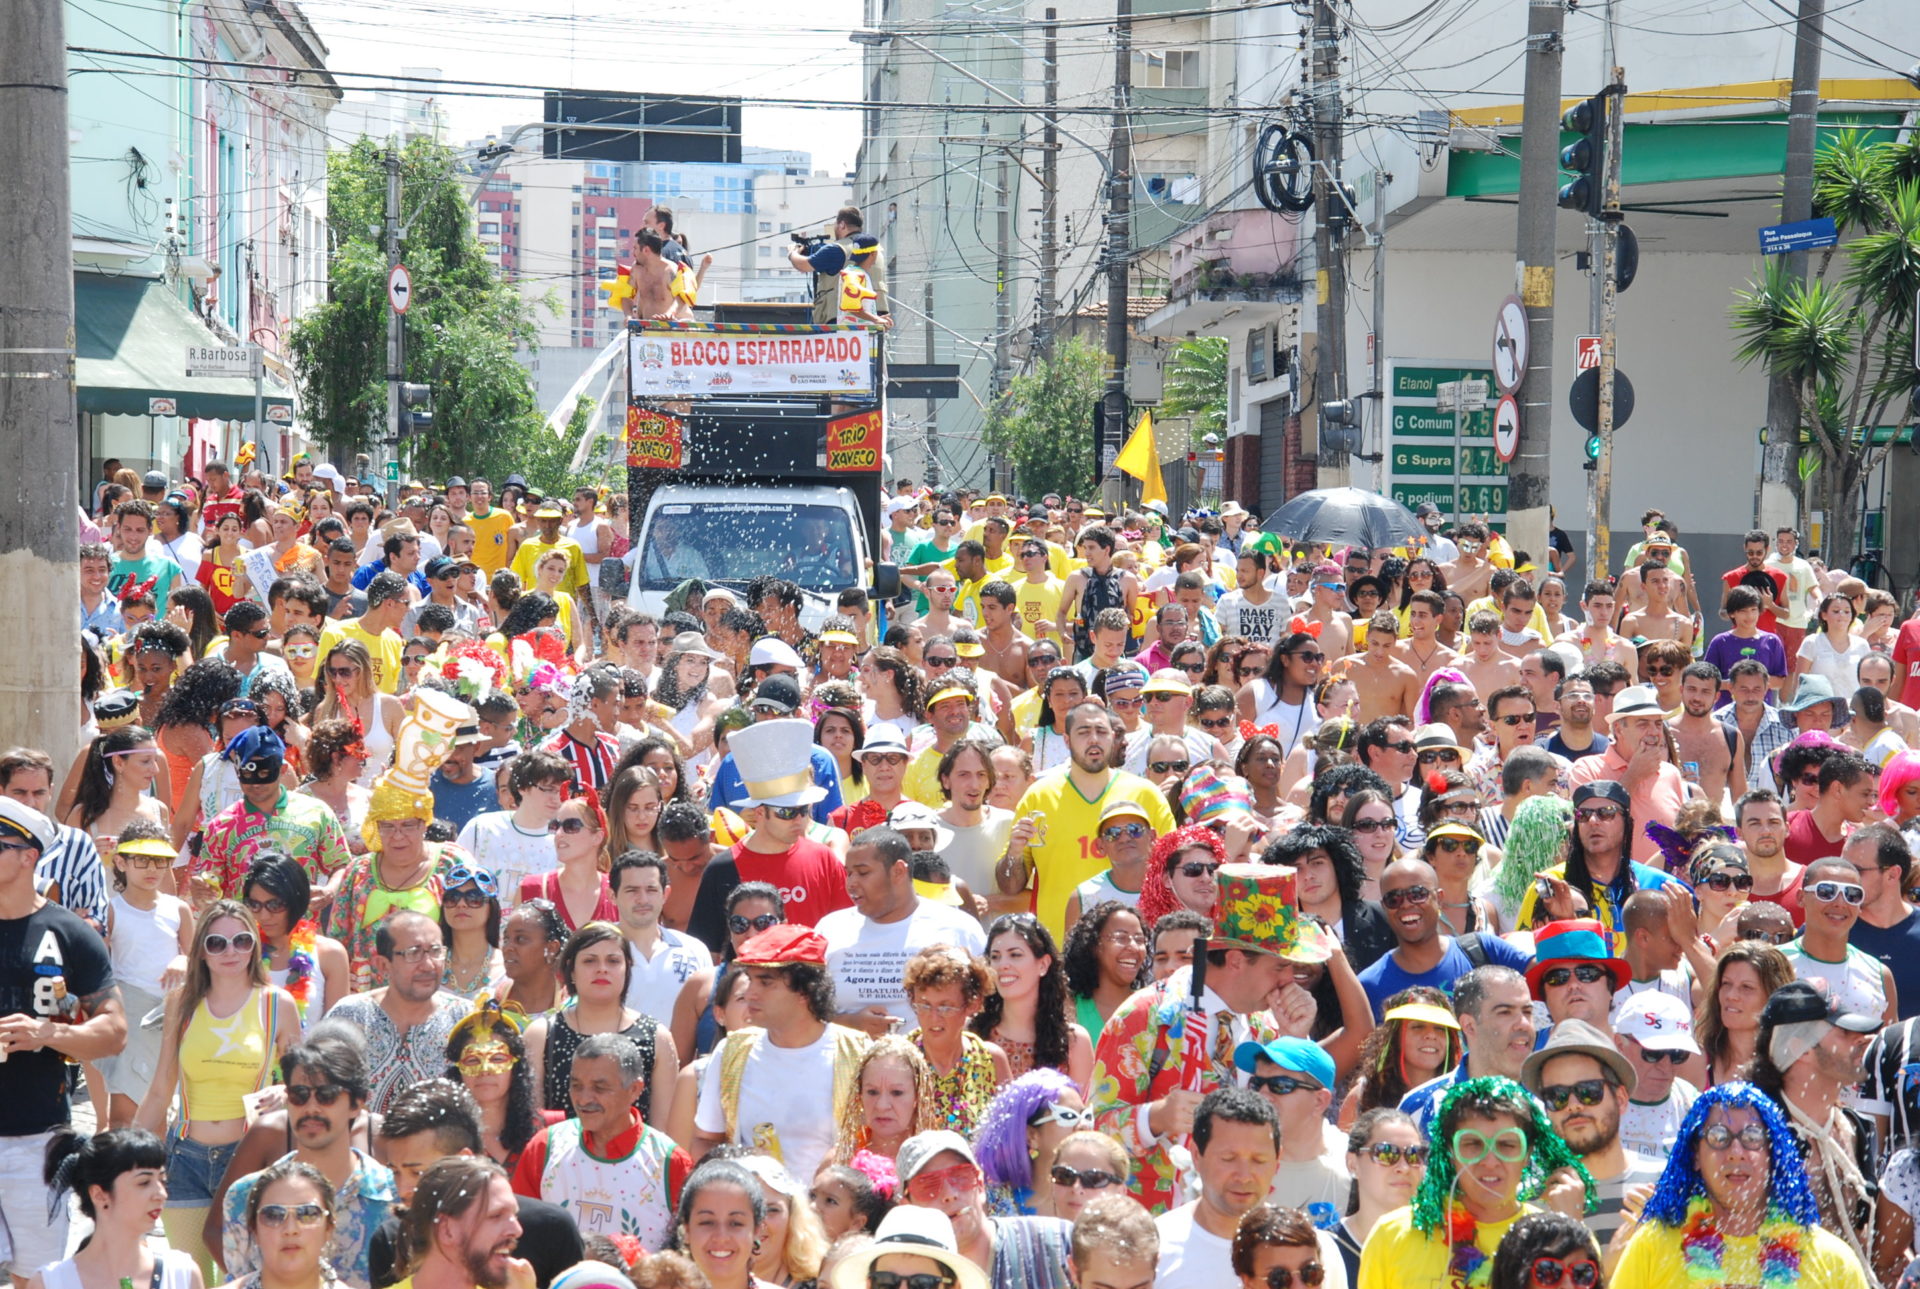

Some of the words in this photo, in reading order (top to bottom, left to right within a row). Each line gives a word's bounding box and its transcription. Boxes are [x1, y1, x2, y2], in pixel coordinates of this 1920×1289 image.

[671, 341, 730, 366] BLOCO
[735, 336, 862, 366] ESFARRAPADO
[1400, 376, 1433, 390] Etanol
[1394, 415, 1404, 429] G
[1409, 415, 1453, 429] Comum
[1461, 409, 1490, 435] 2,5
[629, 439, 673, 460] XAVECO
[830, 449, 876, 468] XAVECO
[1397, 454, 1408, 466] G
[1411, 454, 1452, 468] Supra
[1394, 491, 1404, 501] G
[1408, 492, 1453, 506] podium
[1460, 487, 1503, 513] 3,69
[1240, 608, 1274, 617] MAKE
[1240, 616, 1273, 624] EVERY
[1240, 624, 1273, 637] DAY
[33, 930, 63, 966] A
[845, 976, 875, 984] Agora
[878, 976, 903, 984] fude
